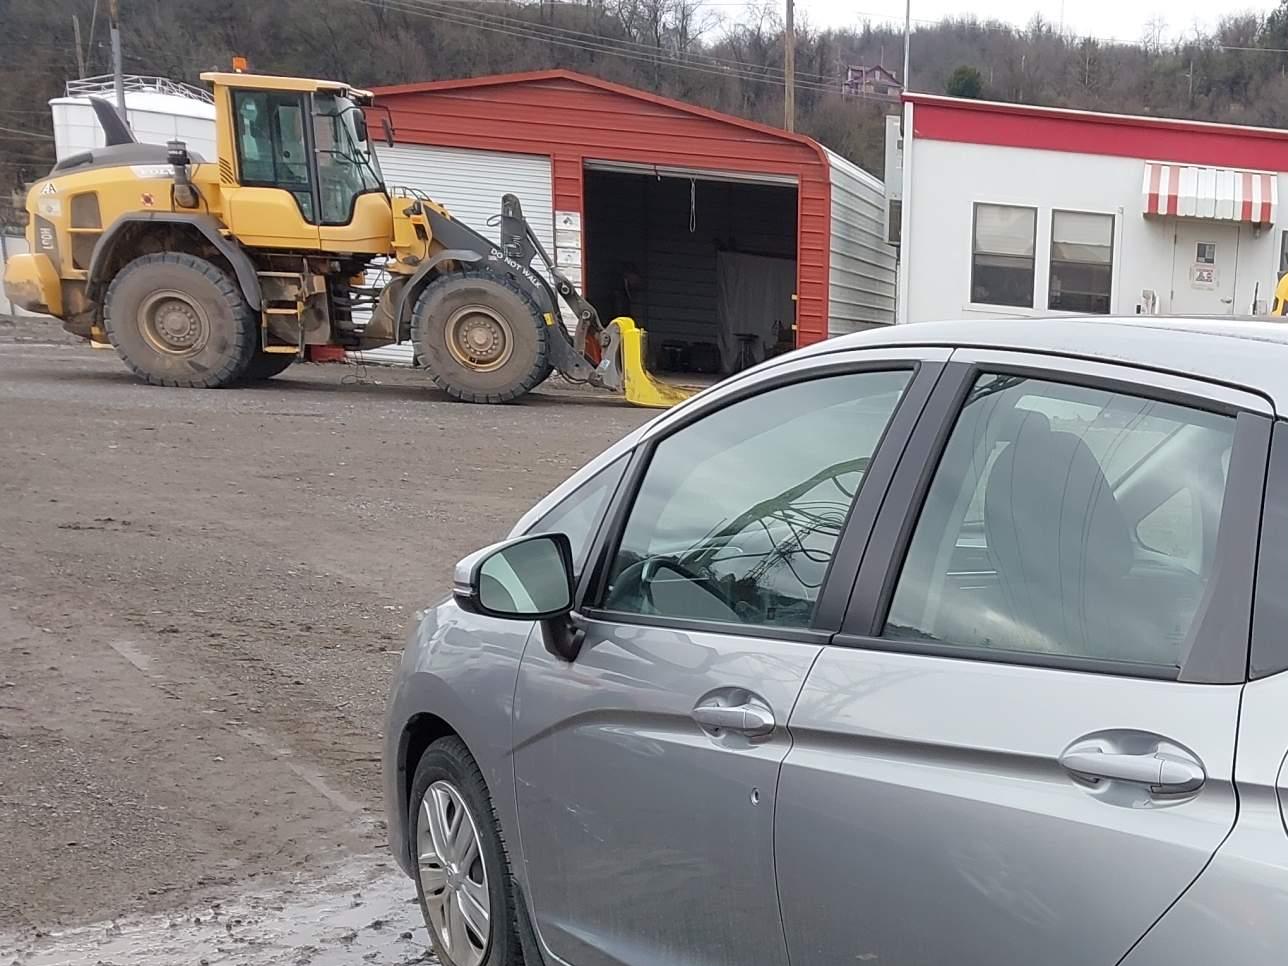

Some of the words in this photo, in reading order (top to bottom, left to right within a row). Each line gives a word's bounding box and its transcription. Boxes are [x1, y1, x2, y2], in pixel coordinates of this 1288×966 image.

[491, 248, 503, 258] DO
[504, 256, 521, 271] NOT
[522, 268, 541, 289] WALK
